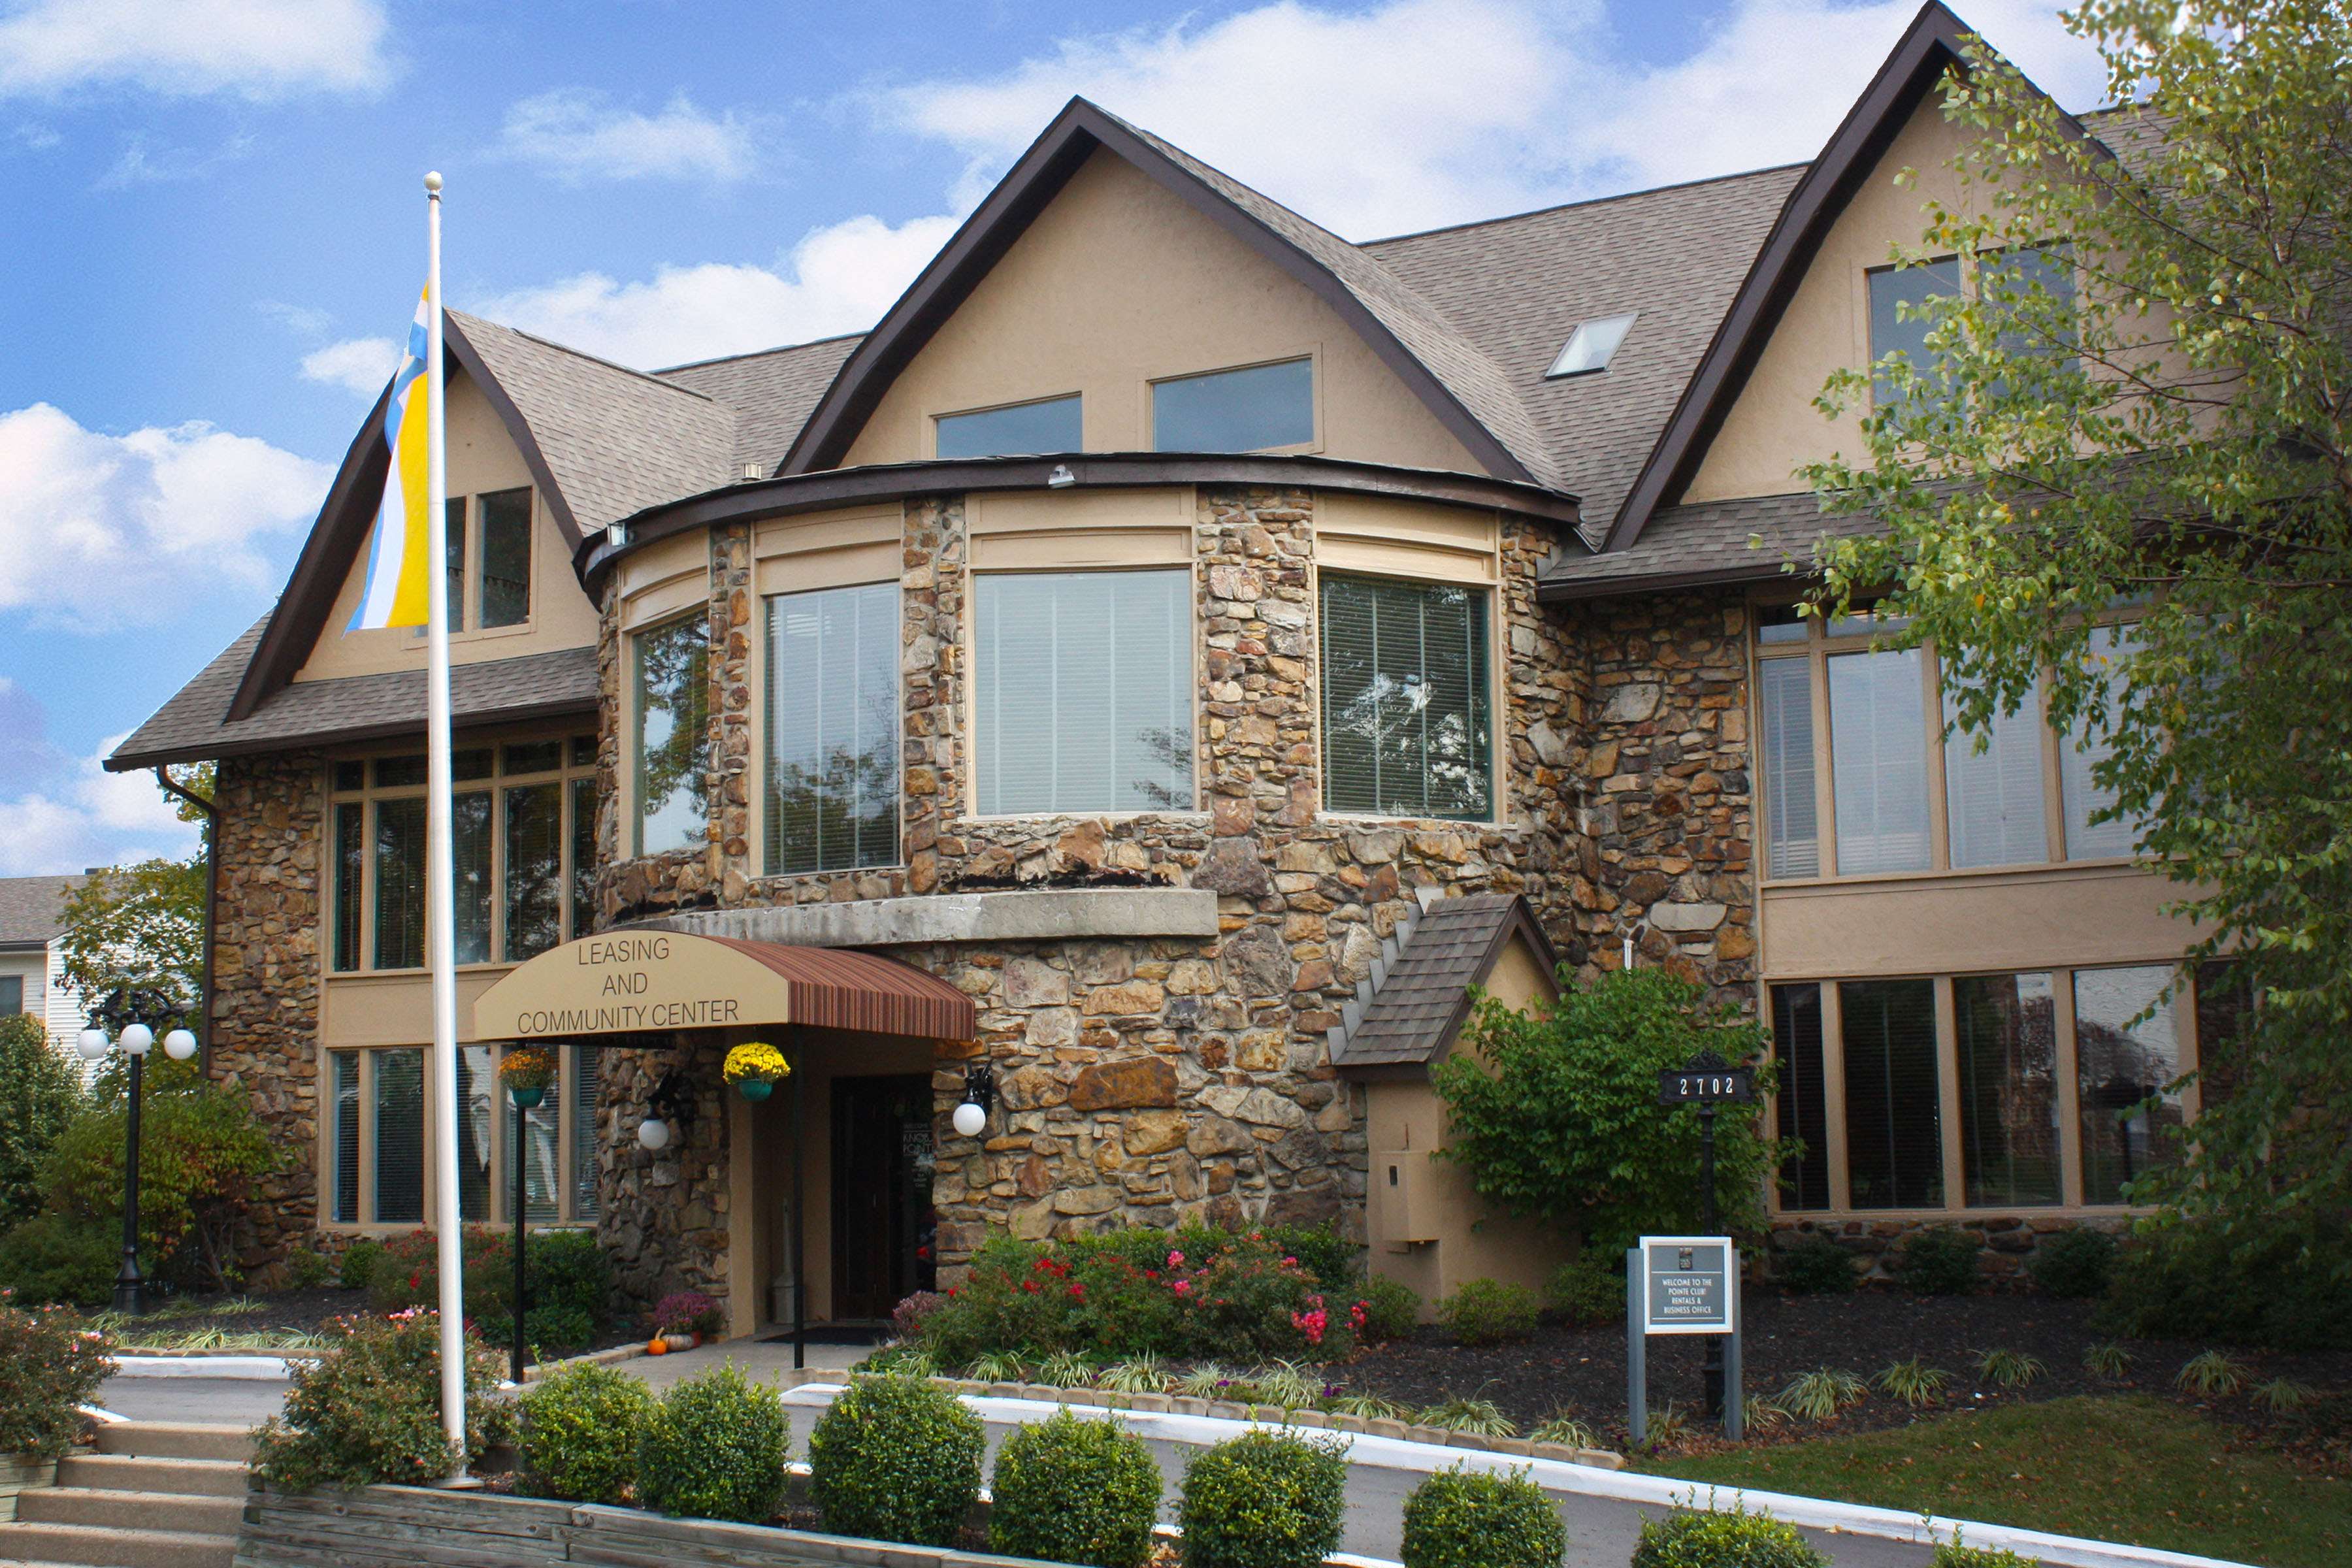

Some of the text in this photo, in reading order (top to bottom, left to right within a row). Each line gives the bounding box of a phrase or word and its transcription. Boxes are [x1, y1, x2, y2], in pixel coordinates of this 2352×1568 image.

[579, 938, 669, 965] LEASING
[602, 973, 648, 996] AND
[518, 1000, 738, 1034] COMMUNITY CENTER
[1680, 1077, 1733, 1095] 2702
